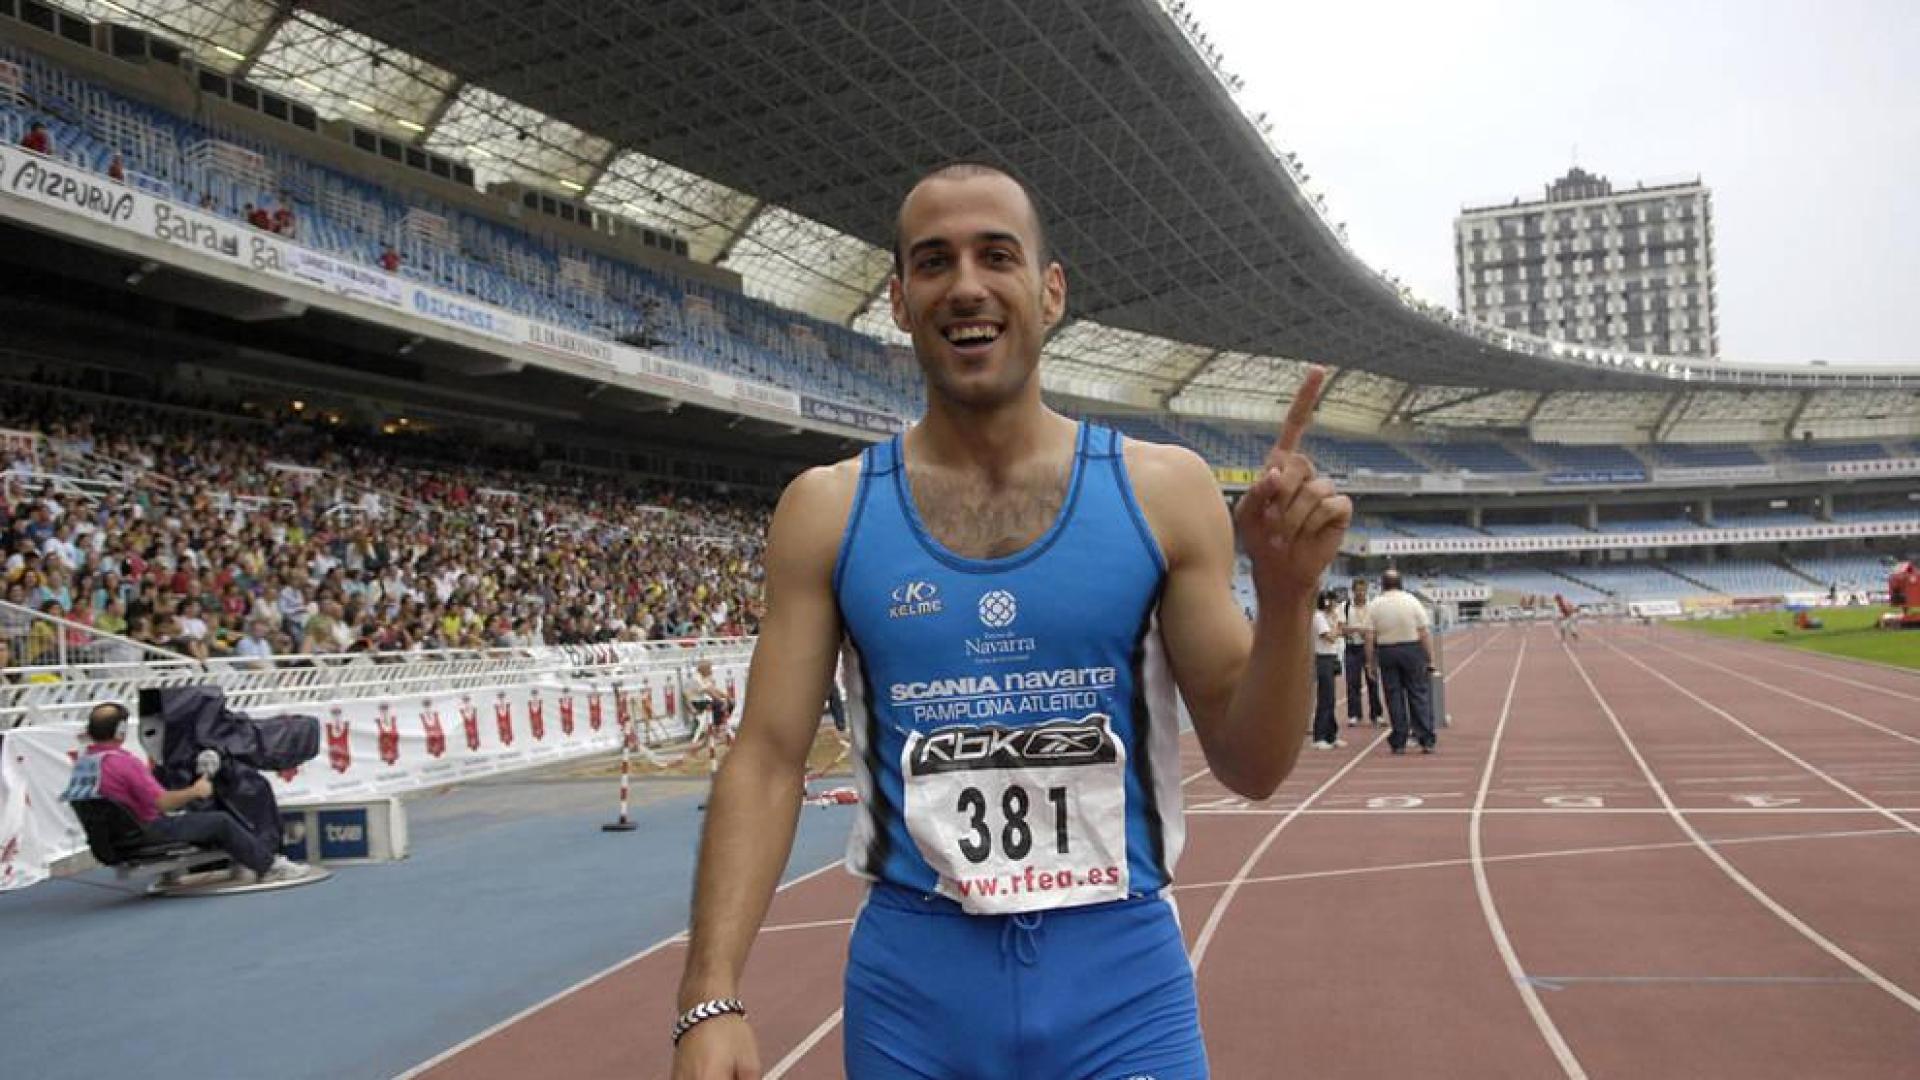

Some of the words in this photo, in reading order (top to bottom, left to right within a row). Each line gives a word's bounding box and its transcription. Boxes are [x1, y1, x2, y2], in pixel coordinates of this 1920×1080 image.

[964, 637, 1035, 656] Navarra
[890, 675, 1000, 701] SCANIA
[1004, 666, 1117, 692] navarra
[913, 698, 1016, 723] PAMPLONA
[1018, 692, 1097, 715] ATLETICO
[957, 784, 1070, 864] 381
